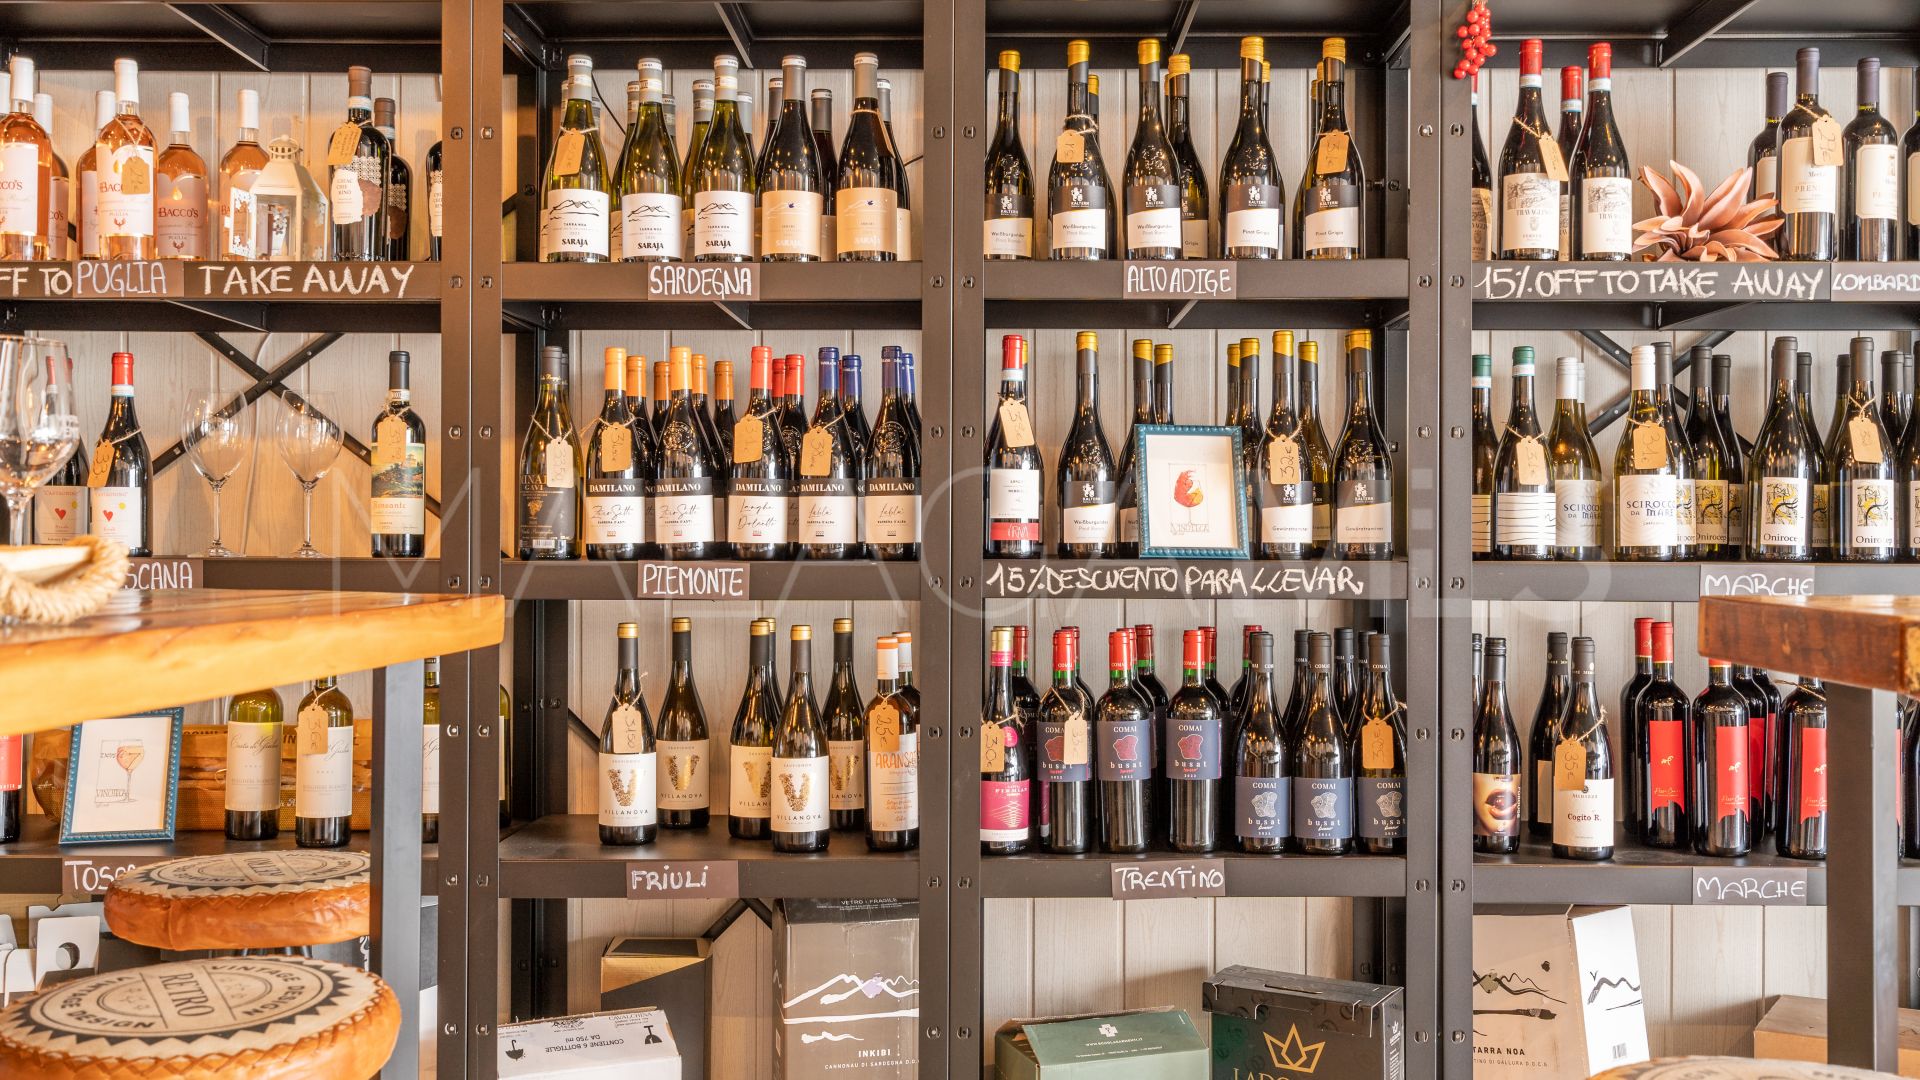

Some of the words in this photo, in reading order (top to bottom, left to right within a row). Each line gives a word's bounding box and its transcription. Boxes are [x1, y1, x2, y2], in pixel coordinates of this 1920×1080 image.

[158, 207, 199, 218] BACCO'S
[561, 238, 588, 248] SARAJA
[637, 242, 664, 251] SARAJA
[705, 239, 732, 249] SARAJA
[77, 261, 168, 297] PUGLIA
[198, 265, 294, 297] TAKE
[302, 264, 415, 298] AWAY
[649, 265, 752, 300] SARDEGNA
[1127, 265, 1167, 293] ALTO
[1170, 266, 1232, 297] ADIGE
[1535, 269, 1598, 298] OFF
[1599, 270, 1640, 295] TO
[1641, 266, 1719, 298] TAKE
[1731, 266, 1824, 300] AWAY
[589, 483, 636, 493] DAMILANO
[657, 483, 702, 493] DAMILANO
[735, 483, 782, 493] DAMILANO
[801, 482, 845, 492] DAMILANO
[869, 482, 915, 492] DAMILANO
[124, 561, 193, 590] SCANA
[642, 563, 744, 597] PIEMONTE
[1046, 565, 1178, 596] DESCUENTO
[1184, 565, 1248, 597] PARA
[1250, 565, 1365, 597] LLEVAR
[1704, 573, 1815, 596] MARCHE
[1045, 726, 1065, 734] COMA
[1113, 725, 1137, 733] COMAI
[1178, 724, 1202, 732] COMAI
[1110, 761, 1143, 769] busat
[1174, 760, 1207, 768] busat
[1248, 818, 1281, 826] busat
[1307, 818, 1341, 826] busat
[1567, 813, 1592, 823] Cogito
[64, 860, 136, 891] TOS
[1696, 877, 1806, 900] MARCHE
[212, 965, 302, 982] VINTAGE
[160, 972, 215, 1017] RETRO
[242, 985, 305, 1016] DESIGN
[67, 1010, 156, 1029] DESIGN
[545, 1043, 582, 1053] BOTTIGLIE
[589, 1038, 625, 1049] CONTIENE
[858, 1048, 891, 1058] INKIBI
[1473, 1046, 1502, 1055] TARRA
[1506, 1047, 1526, 1056] NOA
